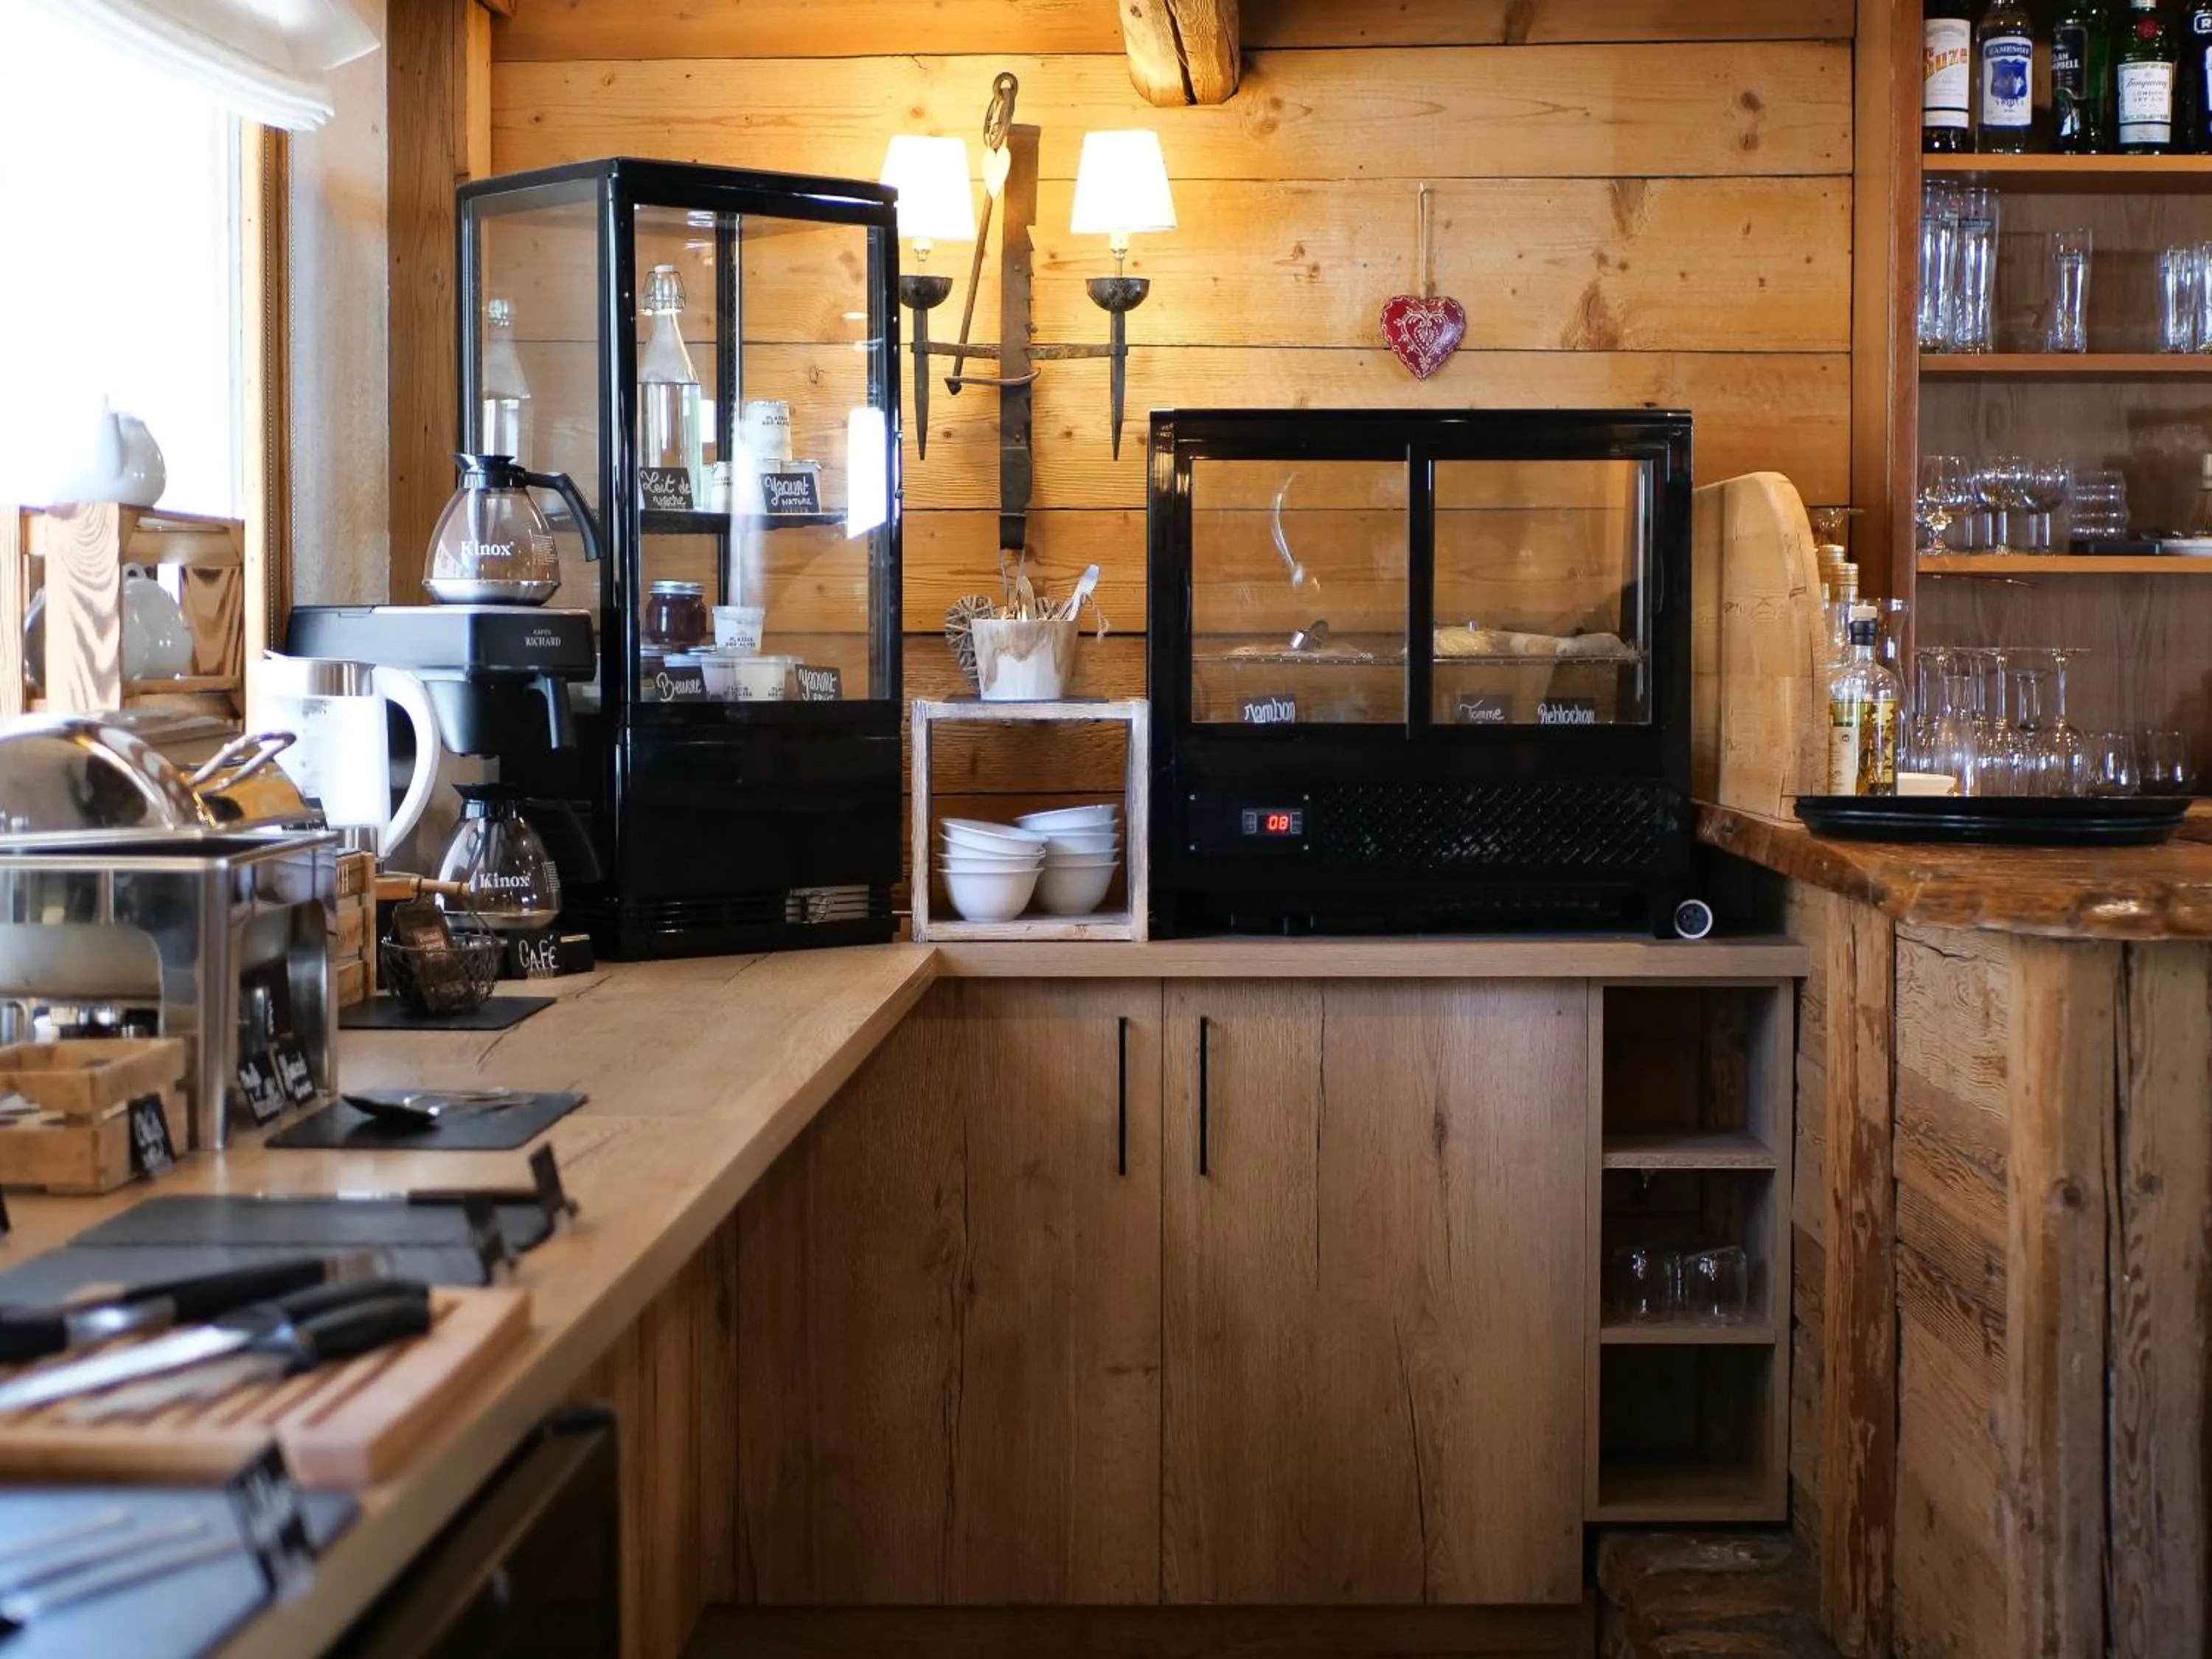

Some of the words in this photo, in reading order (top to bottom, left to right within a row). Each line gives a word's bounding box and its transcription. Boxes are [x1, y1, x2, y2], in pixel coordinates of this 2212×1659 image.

[460, 541, 511, 556] Kinox
[524, 636, 561, 647] RICHARD
[479, 872, 532, 888] Kinox
